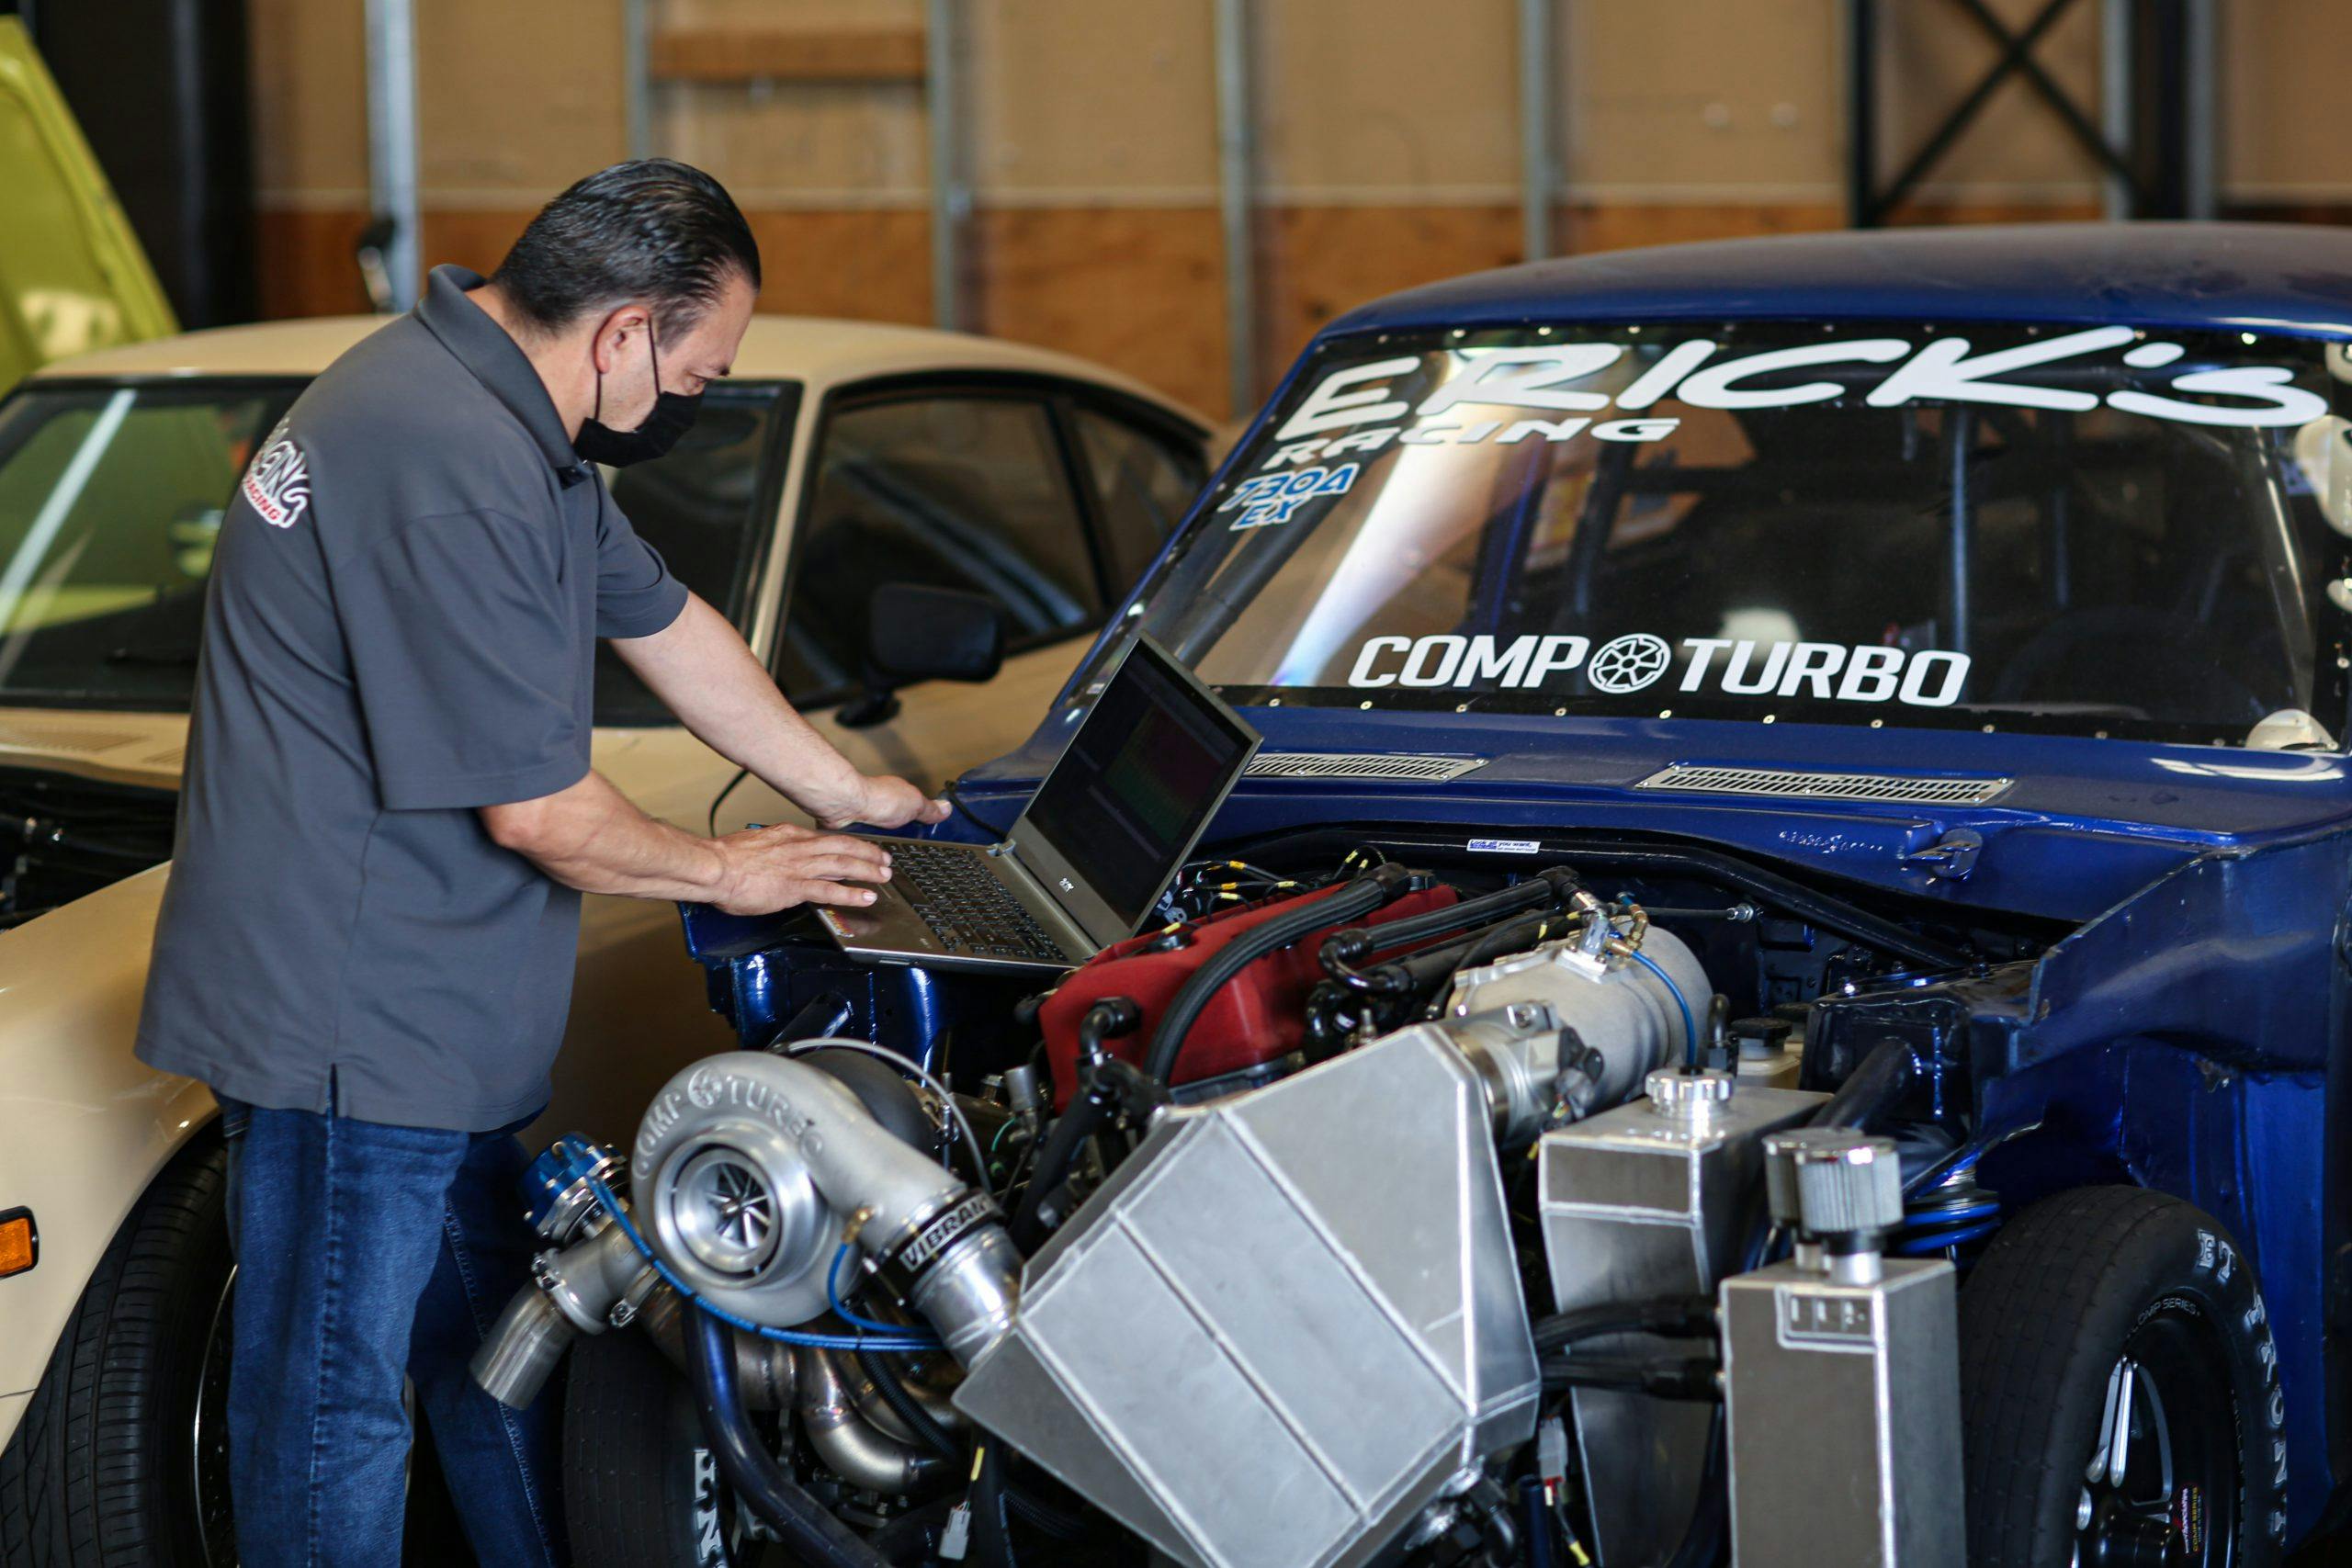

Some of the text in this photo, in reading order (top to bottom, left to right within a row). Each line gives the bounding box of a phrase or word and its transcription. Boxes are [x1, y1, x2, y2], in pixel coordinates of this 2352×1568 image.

[1261, 417, 1680, 470] RACING
[1347, 634, 1972, 707] COMP TURBO
[631, 1075, 824, 1181] COMP TURBO
